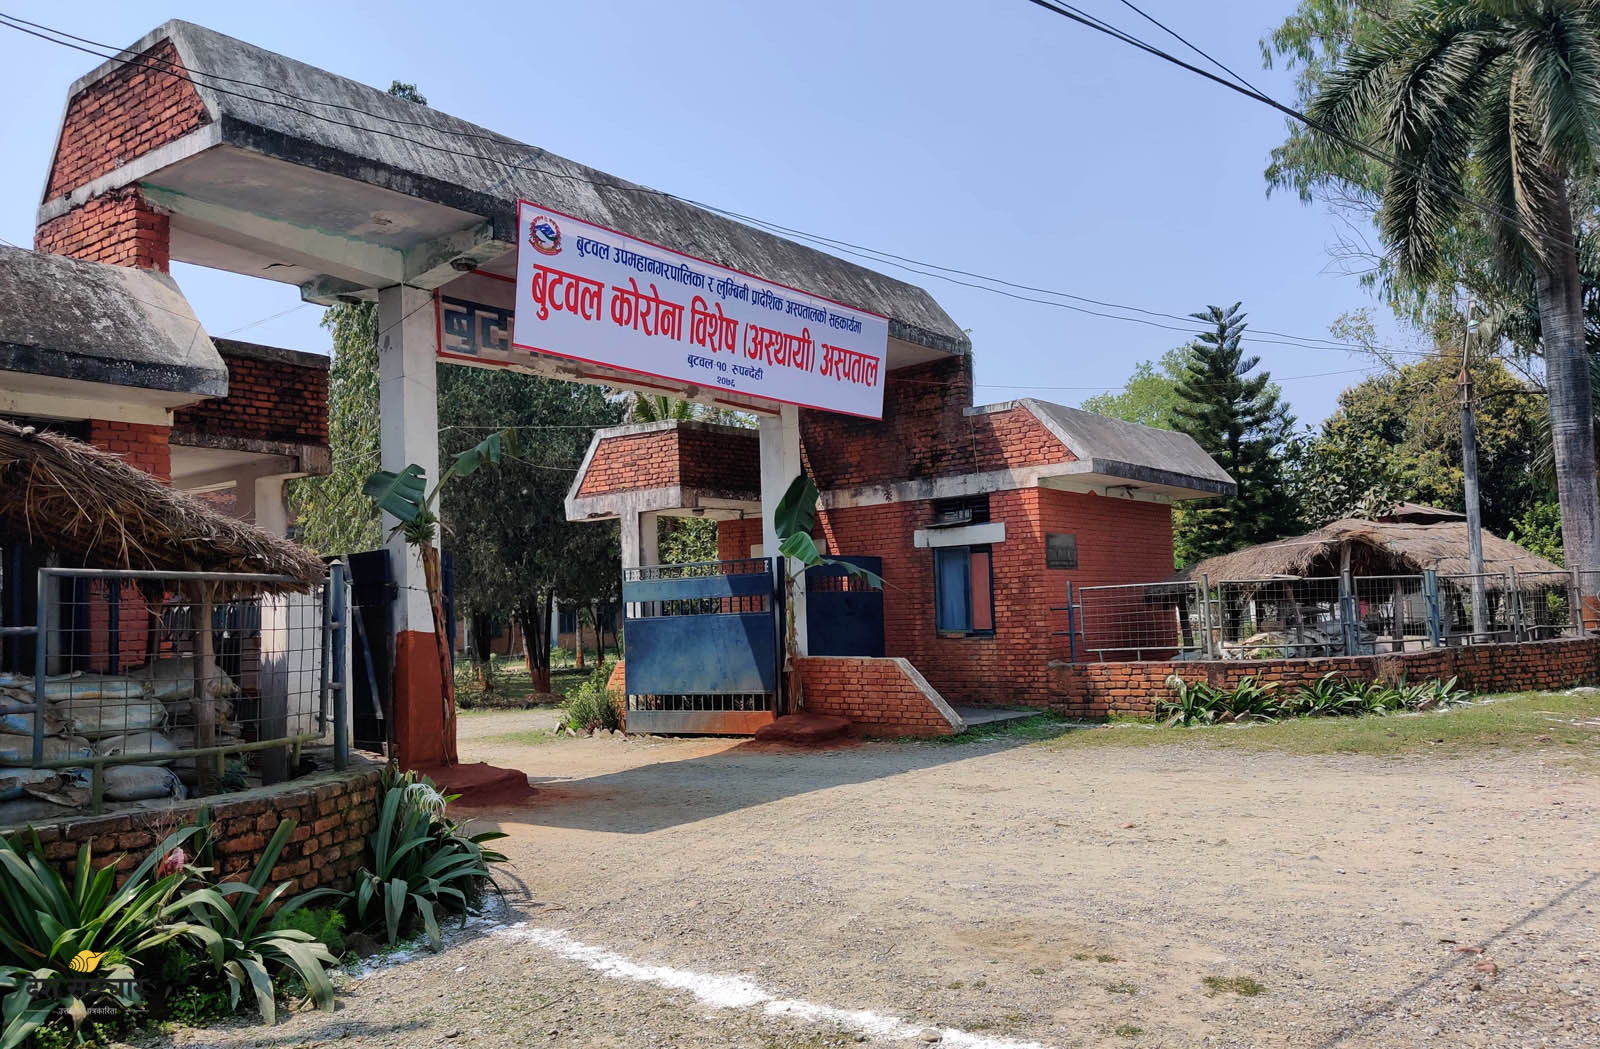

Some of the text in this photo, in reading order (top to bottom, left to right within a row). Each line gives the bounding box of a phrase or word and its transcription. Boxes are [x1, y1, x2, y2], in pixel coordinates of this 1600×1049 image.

[575, 235, 610, 260] बुटवल
[613, 247, 705, 289] उपमहानगरपालिका
[707, 276, 715, 292] र
[717, 278, 749, 302] लुम्बिनी
[751, 288, 784, 312] प्रादेशिक
[786, 300, 827, 324] अस्पतालको
[532, 263, 880, 387] बुटवल कोरोना विशेष (अस्थायी) अस्पताल
[716, 376, 735, 387] २०७६
